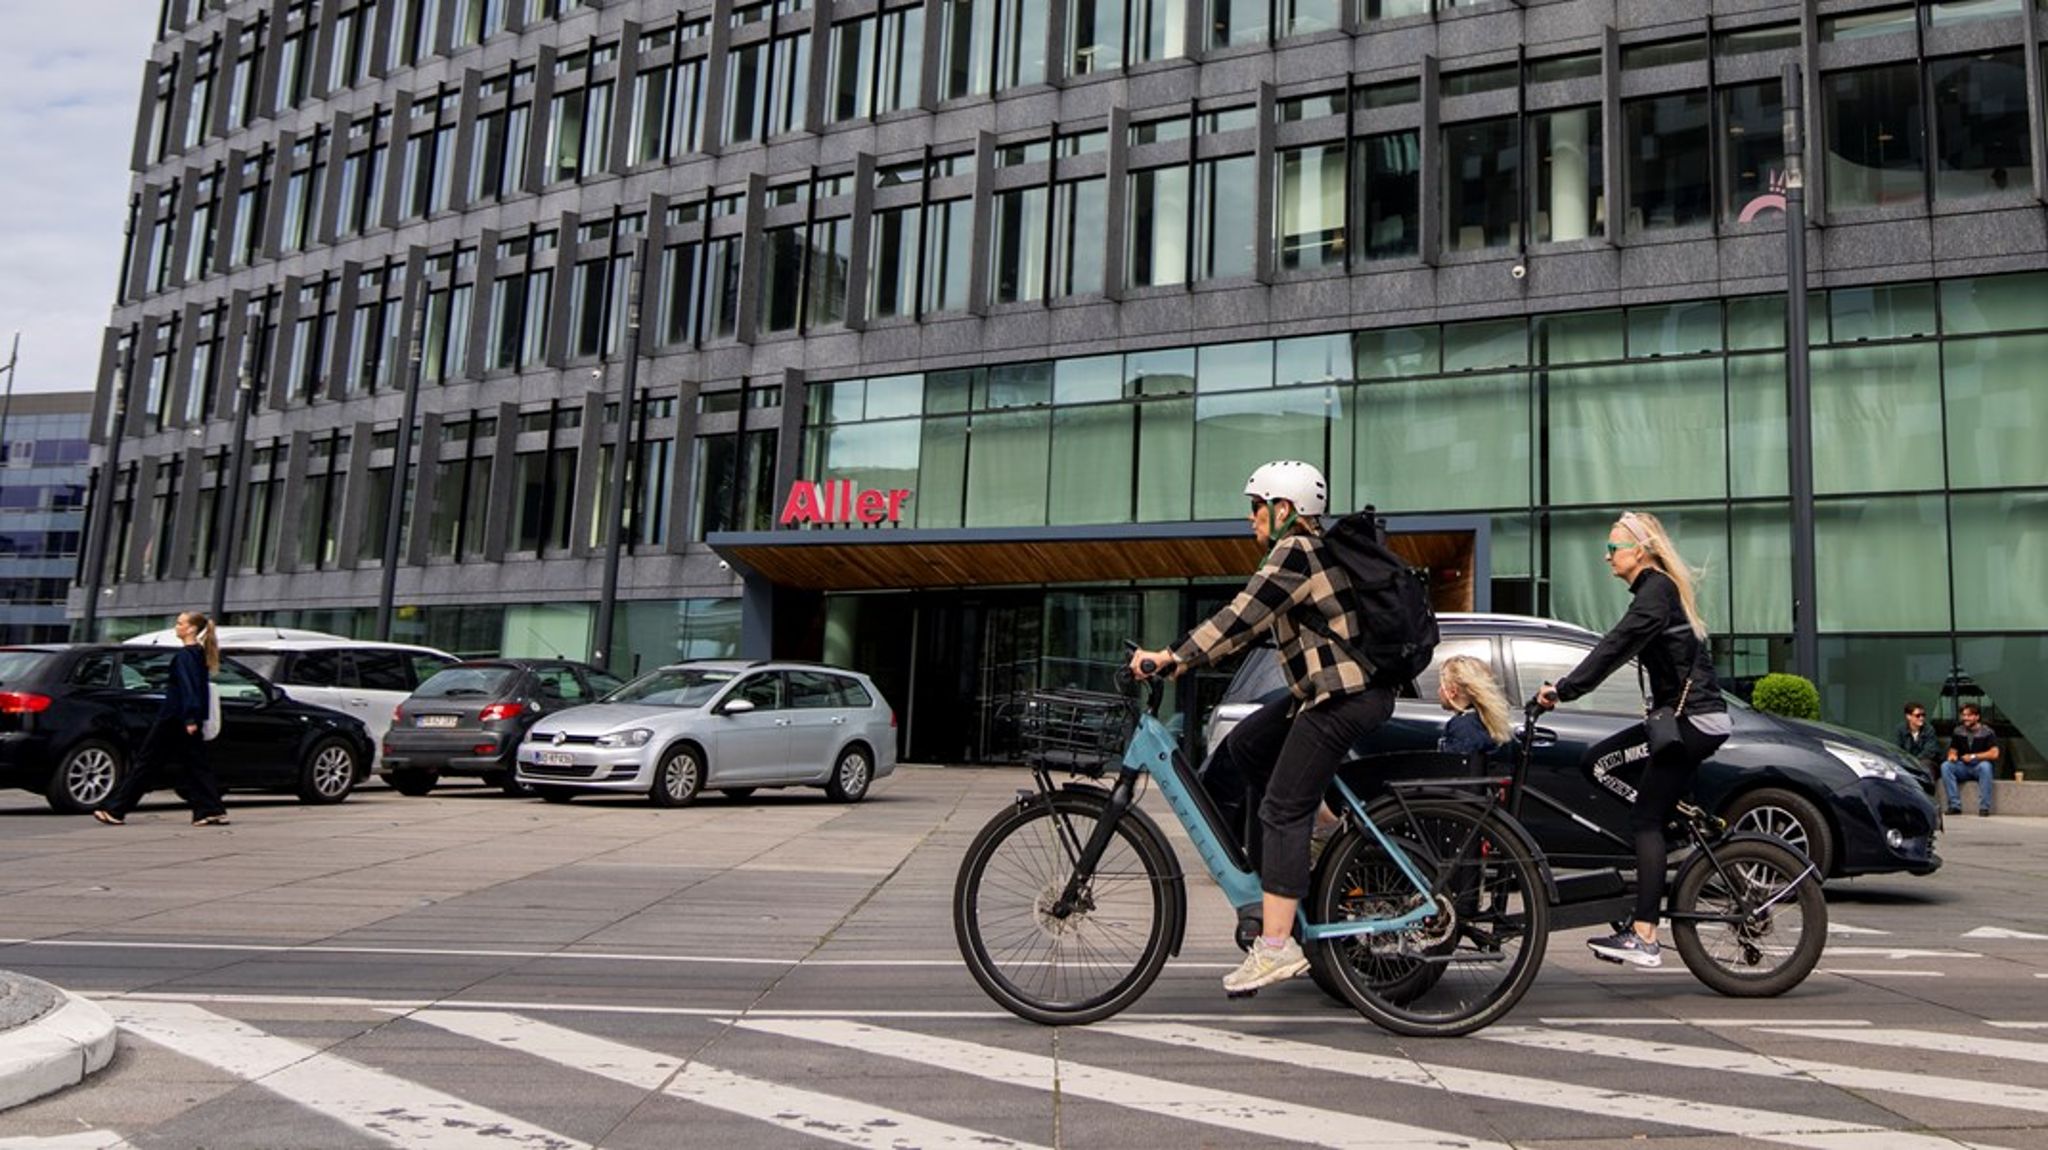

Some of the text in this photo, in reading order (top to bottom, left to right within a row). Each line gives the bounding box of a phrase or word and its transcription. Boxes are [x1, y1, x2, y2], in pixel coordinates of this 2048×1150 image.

[780, 479, 910, 523] Aller
[1624, 742, 1650, 763] NIKE
[1160, 779, 1226, 879] GAZELLE
